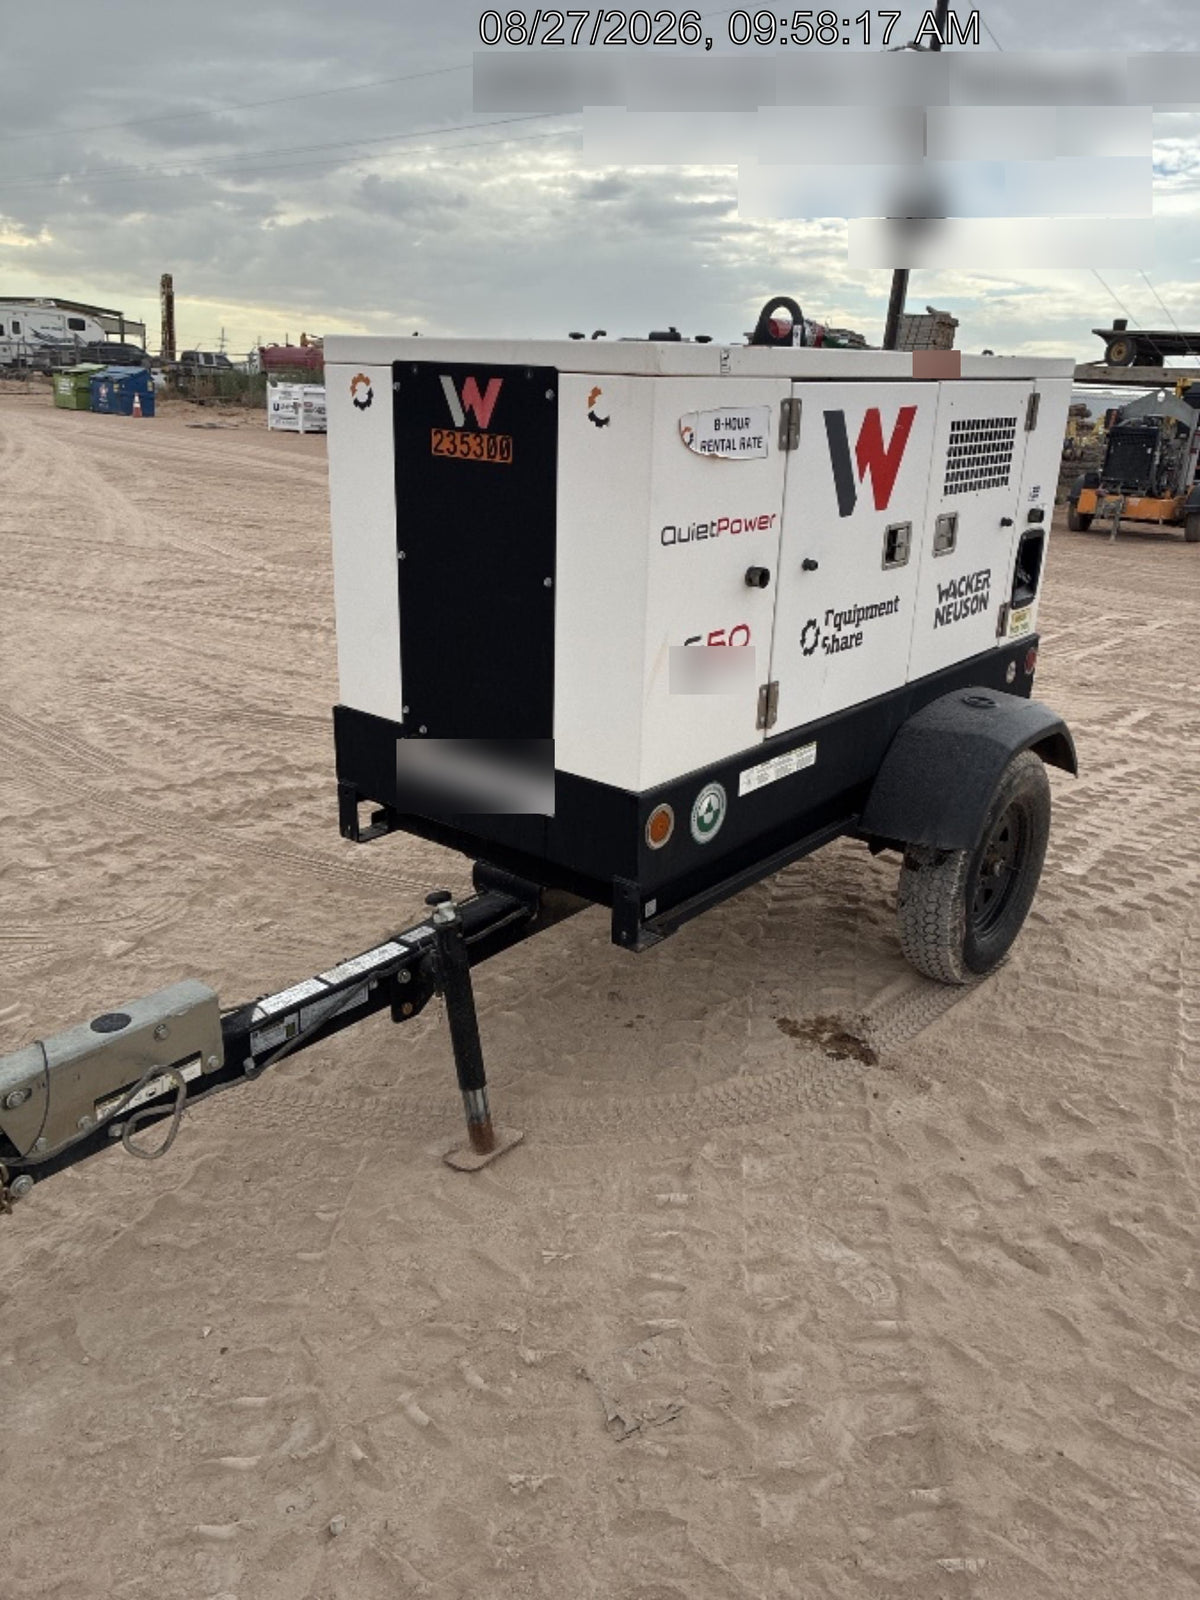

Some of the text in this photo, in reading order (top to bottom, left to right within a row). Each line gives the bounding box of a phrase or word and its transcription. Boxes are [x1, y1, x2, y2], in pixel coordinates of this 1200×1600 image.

[439, 374, 504, 429] W
[433, 430, 511, 461] 235300
[700, 436, 763, 452] RENTAL RATE
[823, 405, 918, 517] W
[661, 513, 776, 546] QuietPower
[937, 568, 991, 604] WACKER
[933, 591, 990, 629] NEUSON
[821, 631, 863, 654] Share
